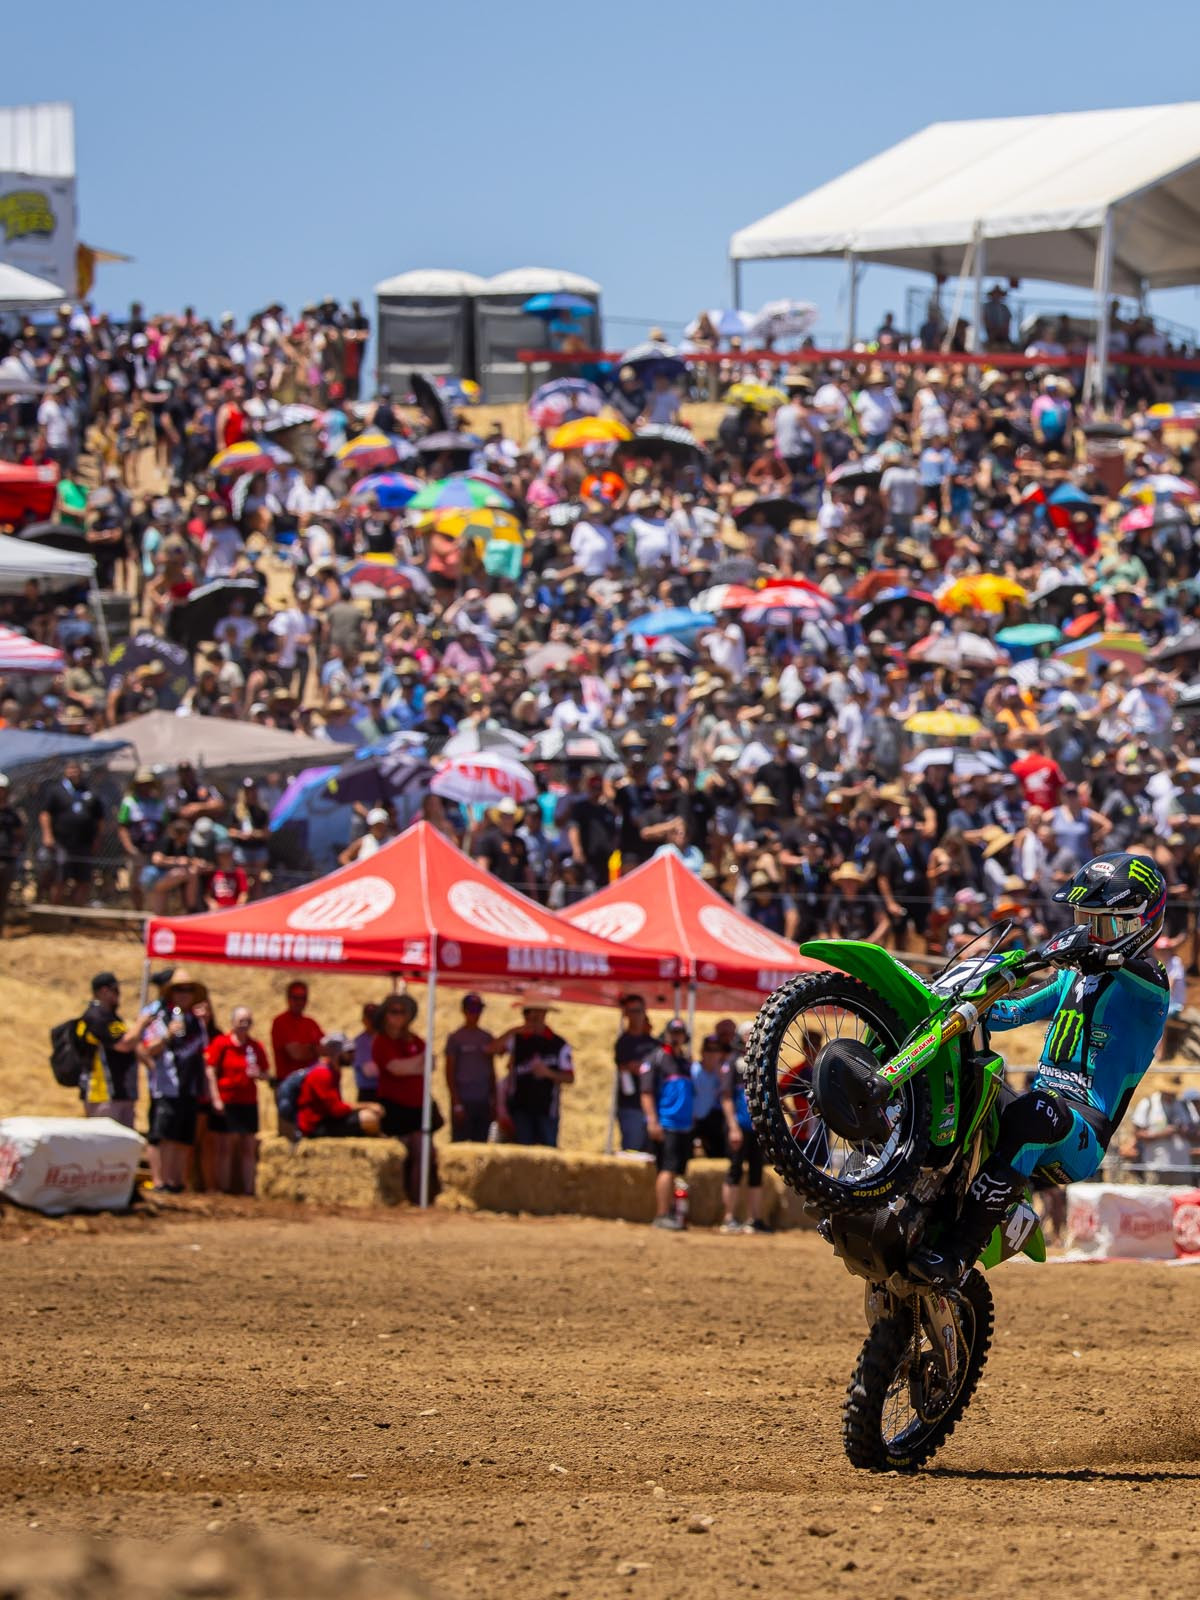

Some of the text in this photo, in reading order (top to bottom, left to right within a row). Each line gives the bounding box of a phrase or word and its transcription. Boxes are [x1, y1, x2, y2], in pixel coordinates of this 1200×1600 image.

[911, 1034, 937, 1058] BRAKING
[1035, 1098, 1060, 1127] FOX
[852, 1182, 892, 1198] DUNLOP
[1005, 1204, 1036, 1251] 47
